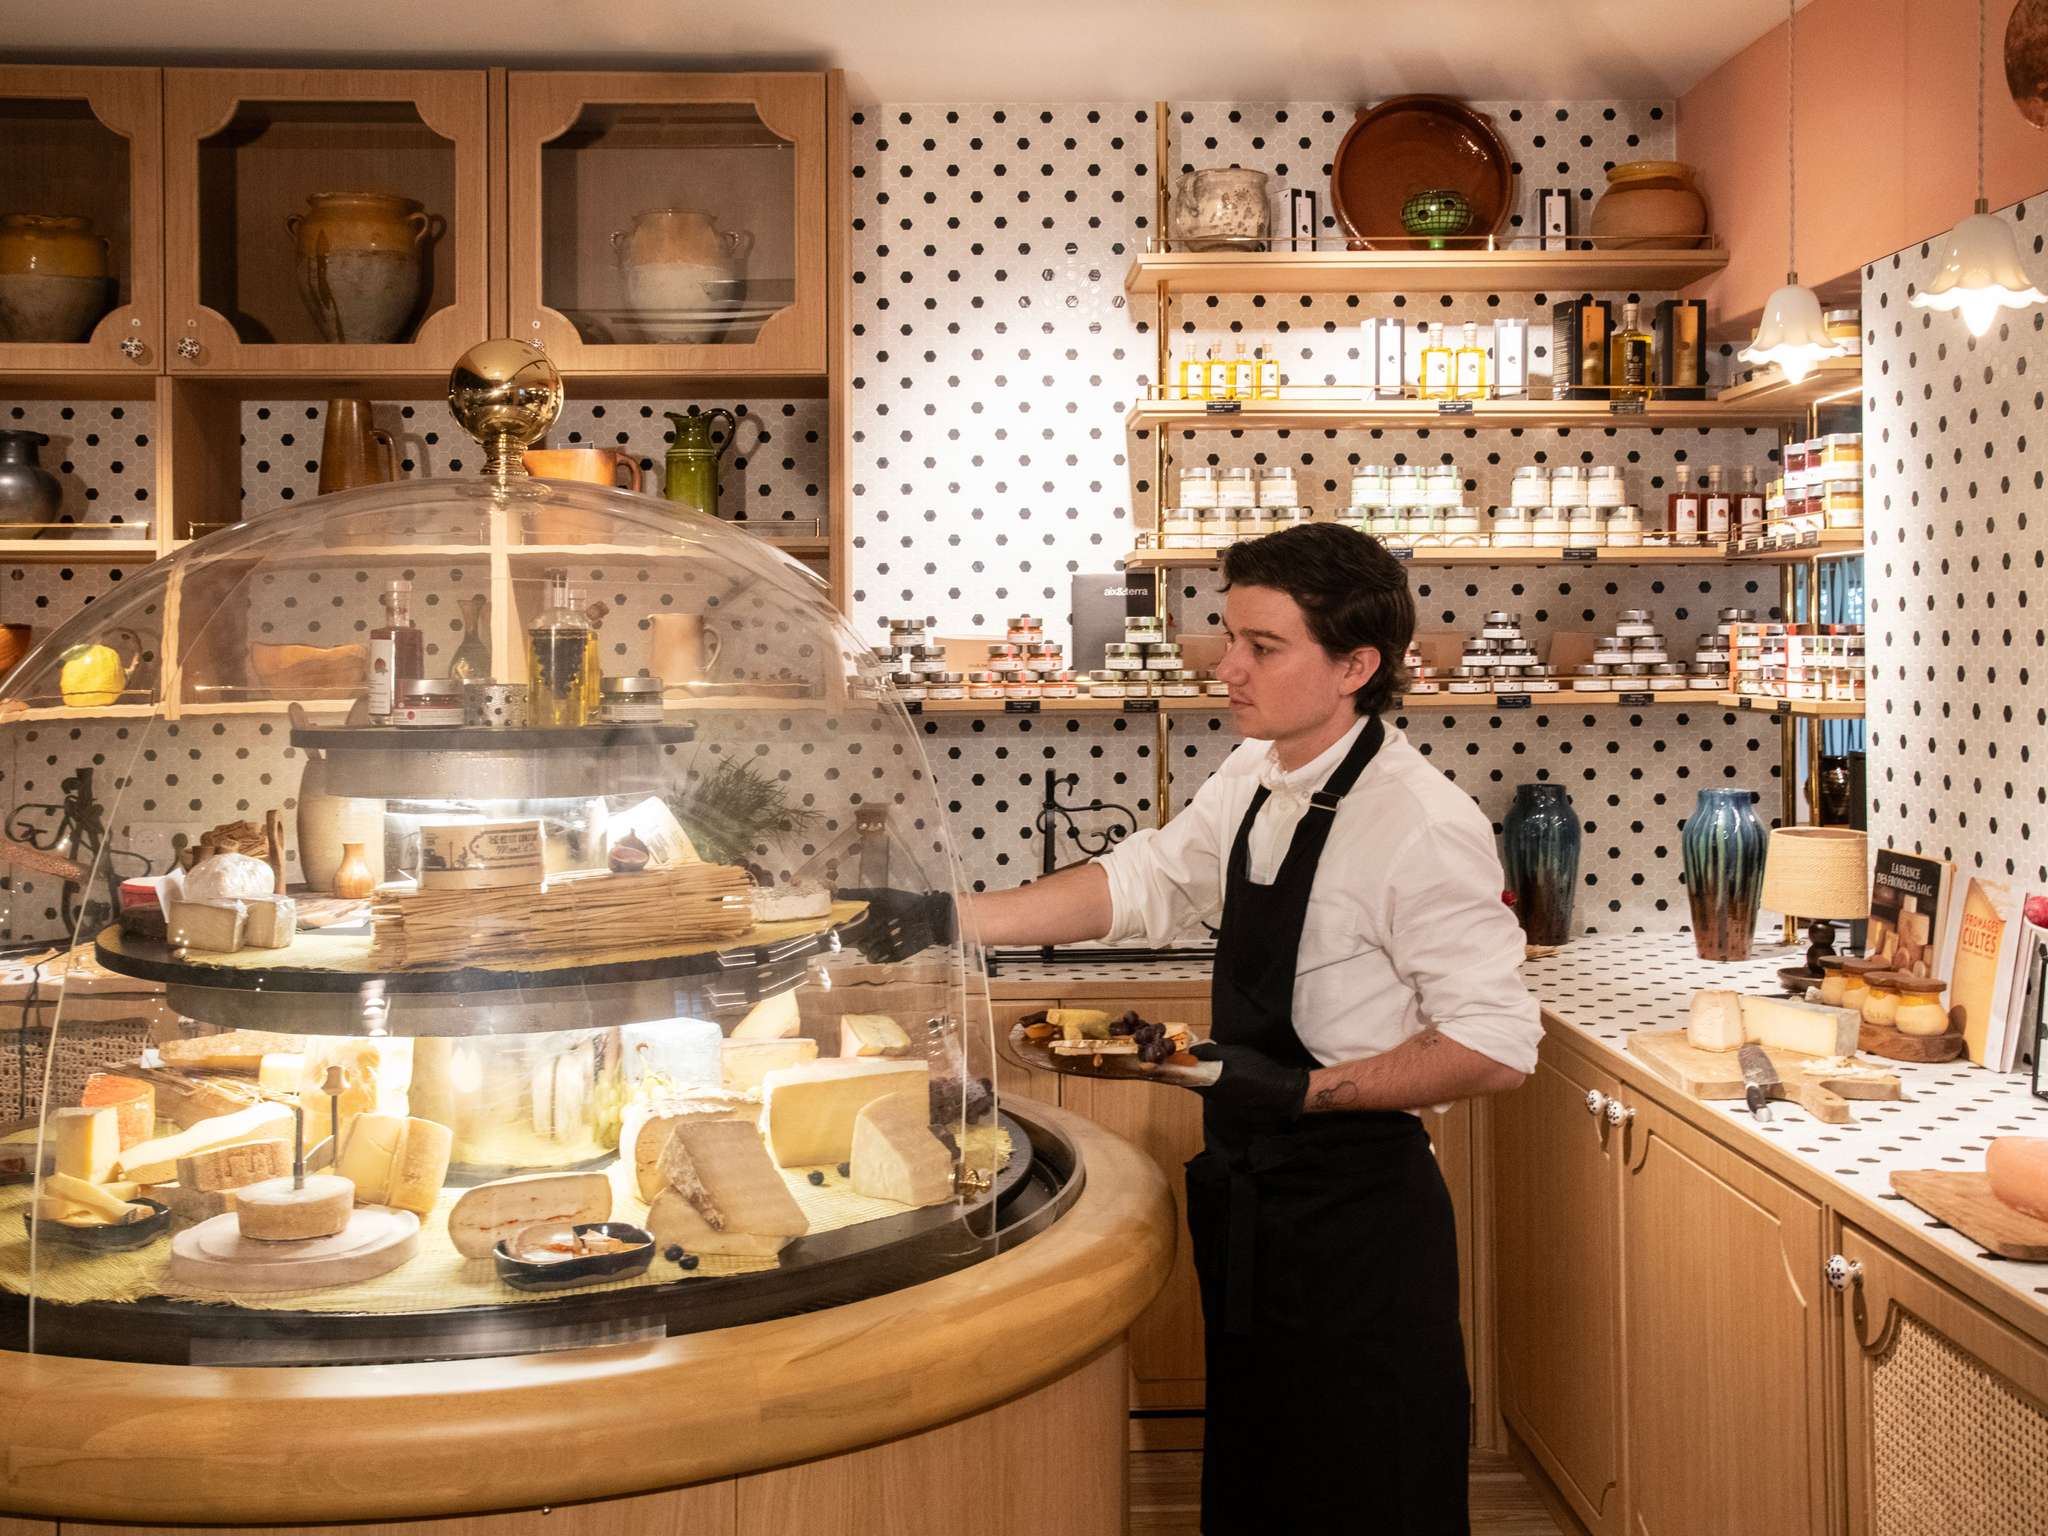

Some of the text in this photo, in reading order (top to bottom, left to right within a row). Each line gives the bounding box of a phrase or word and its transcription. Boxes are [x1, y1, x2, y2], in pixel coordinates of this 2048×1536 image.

[1104, 586, 1149, 597] aix&terra
[1899, 863, 1921, 880] FRANCE
[1876, 872, 1888, 885] DES
[1887, 875, 1917, 892] FROMAGES
[1965, 911, 1999, 934] FROMAGES
[1962, 927, 1997, 954] CULTES
